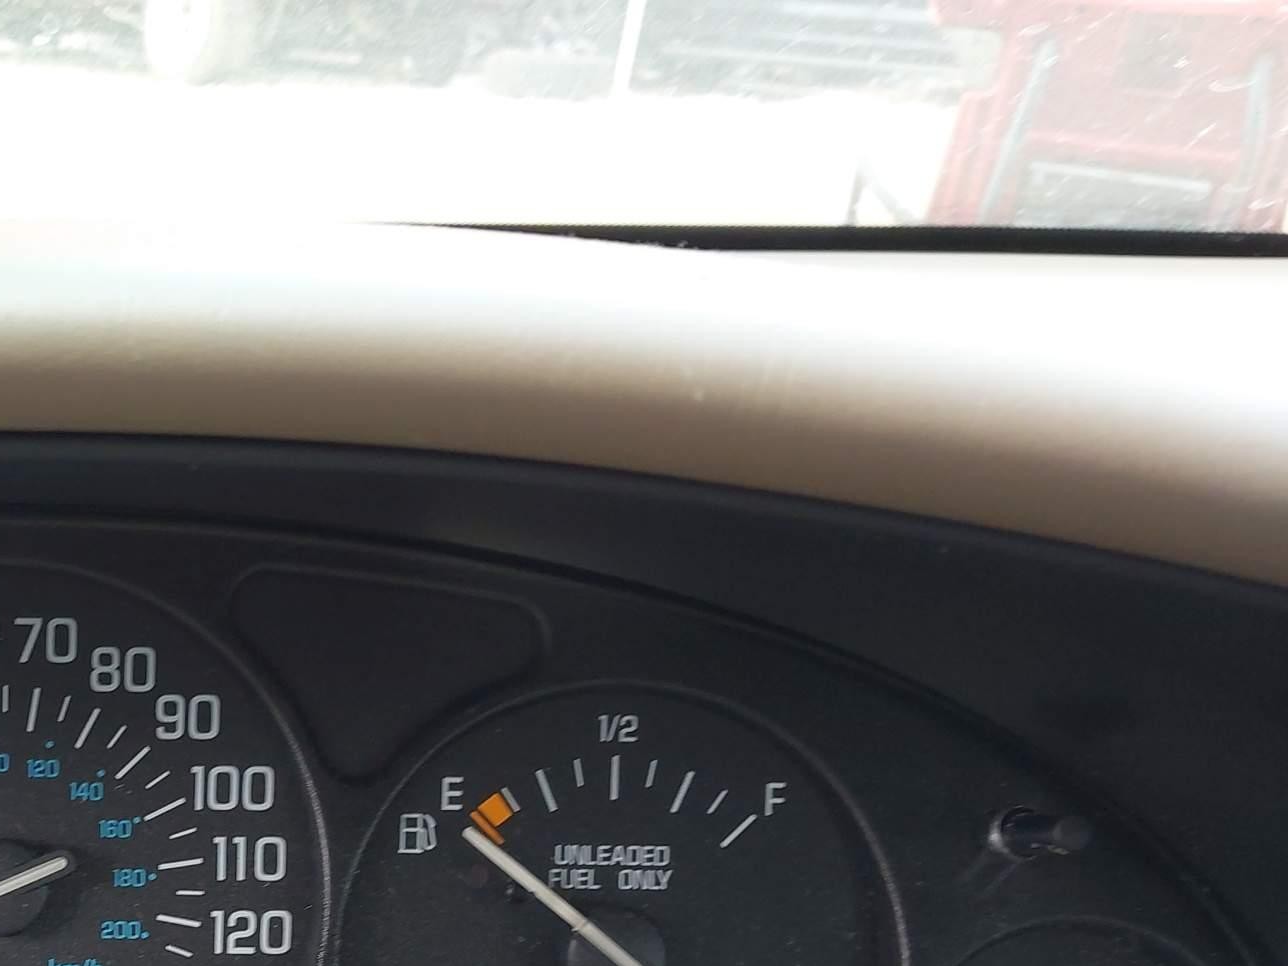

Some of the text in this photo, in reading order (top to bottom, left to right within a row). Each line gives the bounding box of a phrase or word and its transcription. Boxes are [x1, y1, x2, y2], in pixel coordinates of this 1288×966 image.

[14, 617, 78, 664] 70
[90, 646, 156, 692] 80
[155, 694, 220, 740] 90
[599, 714, 638, 742] 1/2
[27, 759, 60, 778] 120
[70, 781, 104, 801] 140
[191, 766, 275, 812] 100
[441, 777, 465, 810] E
[765, 782, 787, 815] F
[98, 819, 132, 838] 160
[212, 836, 287, 882] 110
[554, 845, 671, 866] UNLEADED
[112, 868, 146, 888] 180
[548, 868, 673, 890] FUEL ONLY
[100, 921, 138, 940] 200
[210, 909, 292, 955] 120
